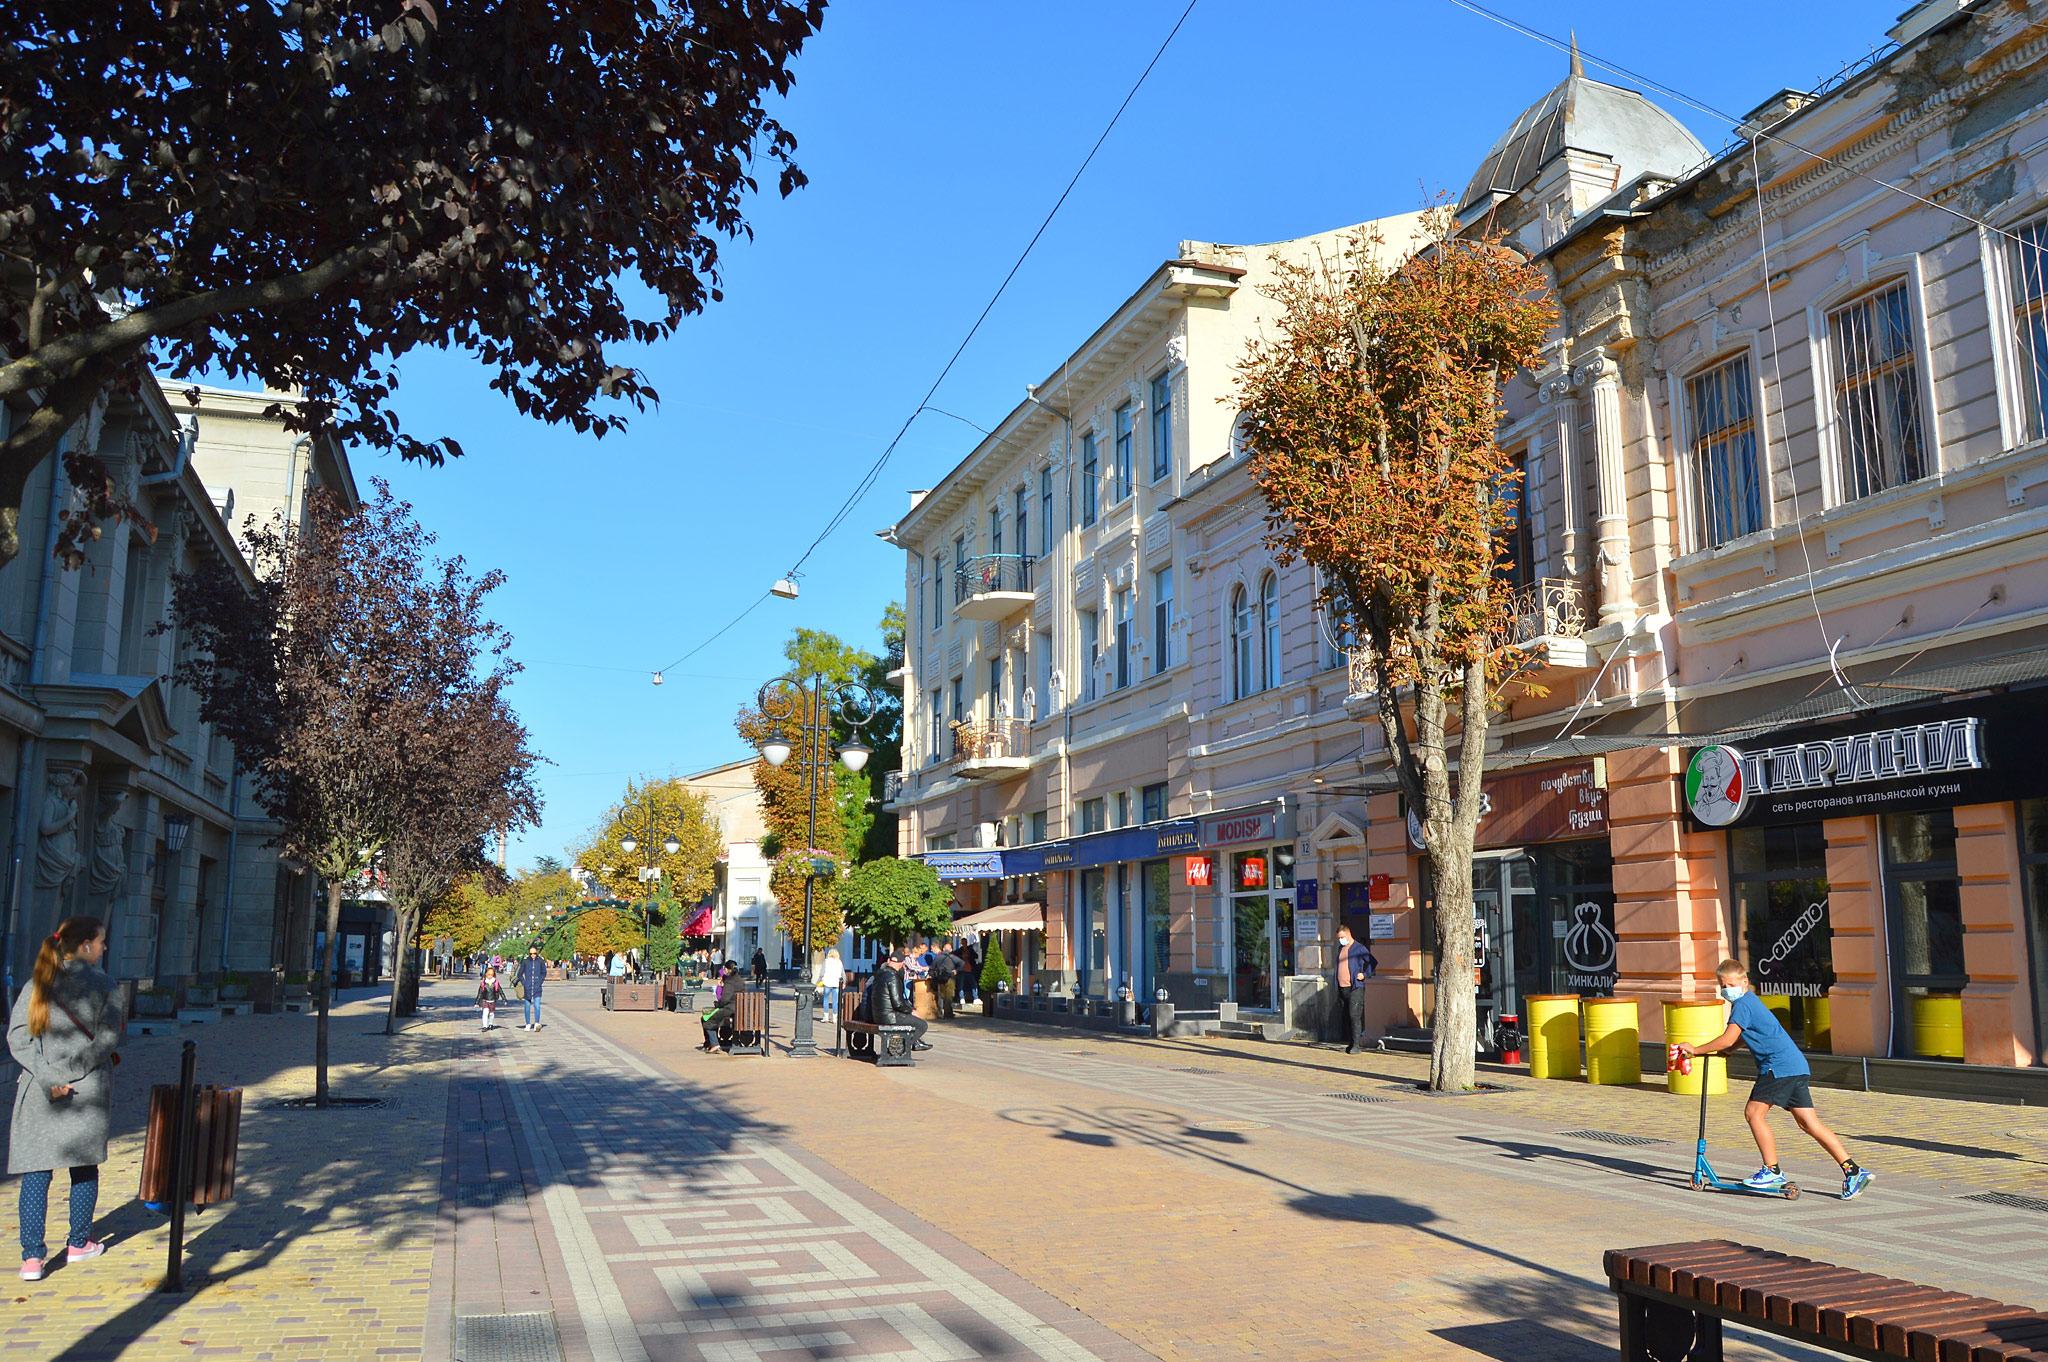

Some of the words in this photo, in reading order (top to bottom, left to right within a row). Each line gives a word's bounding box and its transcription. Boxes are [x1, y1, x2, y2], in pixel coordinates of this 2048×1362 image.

[1744, 717, 1981, 796] ГАРИНИ
[1579, 788, 1602, 808] вкус
[1772, 801, 1794, 813] сеть
[1795, 795, 1854, 812] ресторанов
[1856, 785, 1925, 804] итальянской
[1927, 783, 1961, 798] кухни
[1217, 817, 1261, 841] MODISH
[1568, 809, 1603, 830] Грузии
[1302, 843, 1310, 853] 12
[1568, 974, 1614, 988] ХИНКАЛИ
[1760, 982, 1822, 998] ШАШЛЫК
